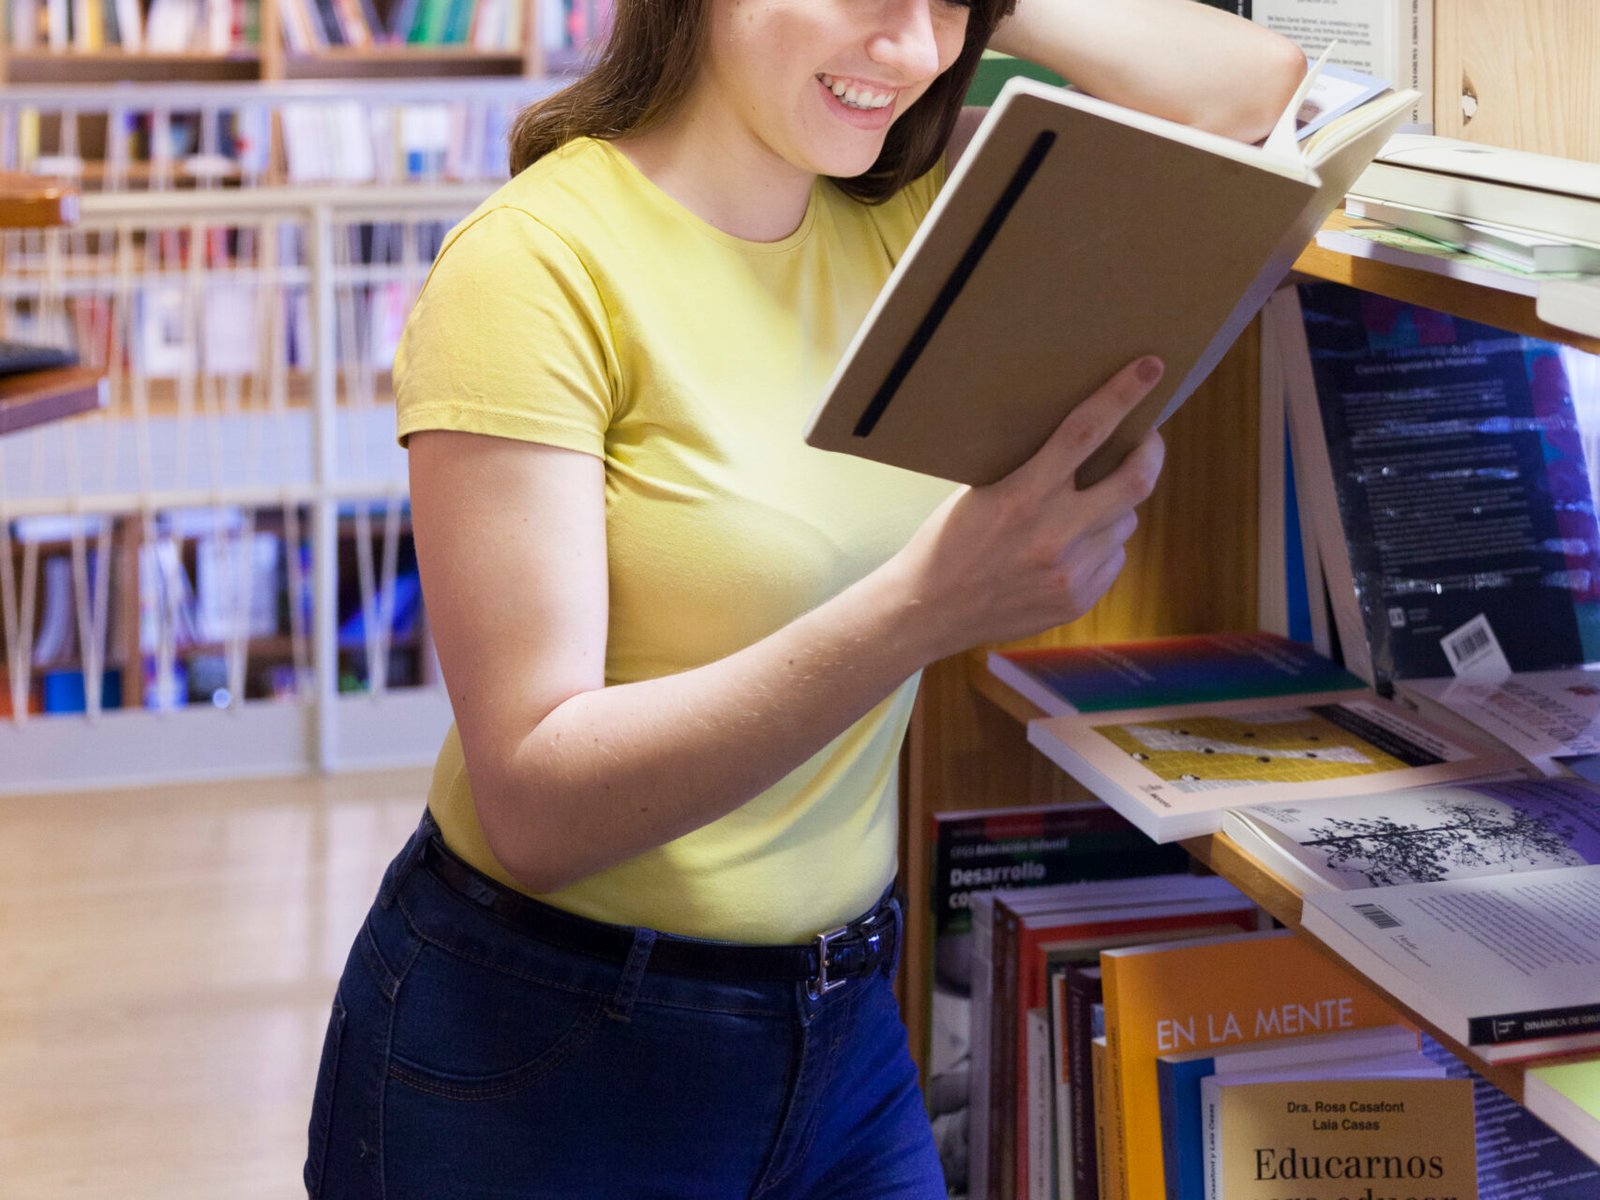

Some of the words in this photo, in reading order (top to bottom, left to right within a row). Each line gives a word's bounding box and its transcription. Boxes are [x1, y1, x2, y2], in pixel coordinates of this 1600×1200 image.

[950, 860, 1047, 886] Desarrollo
[1156, 1015, 1196, 1051] EN
[1207, 1011, 1244, 1043] LA
[1254, 997, 1354, 1038] MENTE
[1523, 1017, 1567, 1031] DINÁMICA
[1567, 1015, 1579, 1025] DE
[1286, 1100, 1311, 1114] Dra.
[1314, 1100, 1347, 1114] Rosa
[1349, 1100, 1405, 1114] Casafont
[1312, 1119, 1338, 1131] Laia
[1341, 1119, 1381, 1131] Casas
[1254, 1146, 1444, 1181] Educarnos
